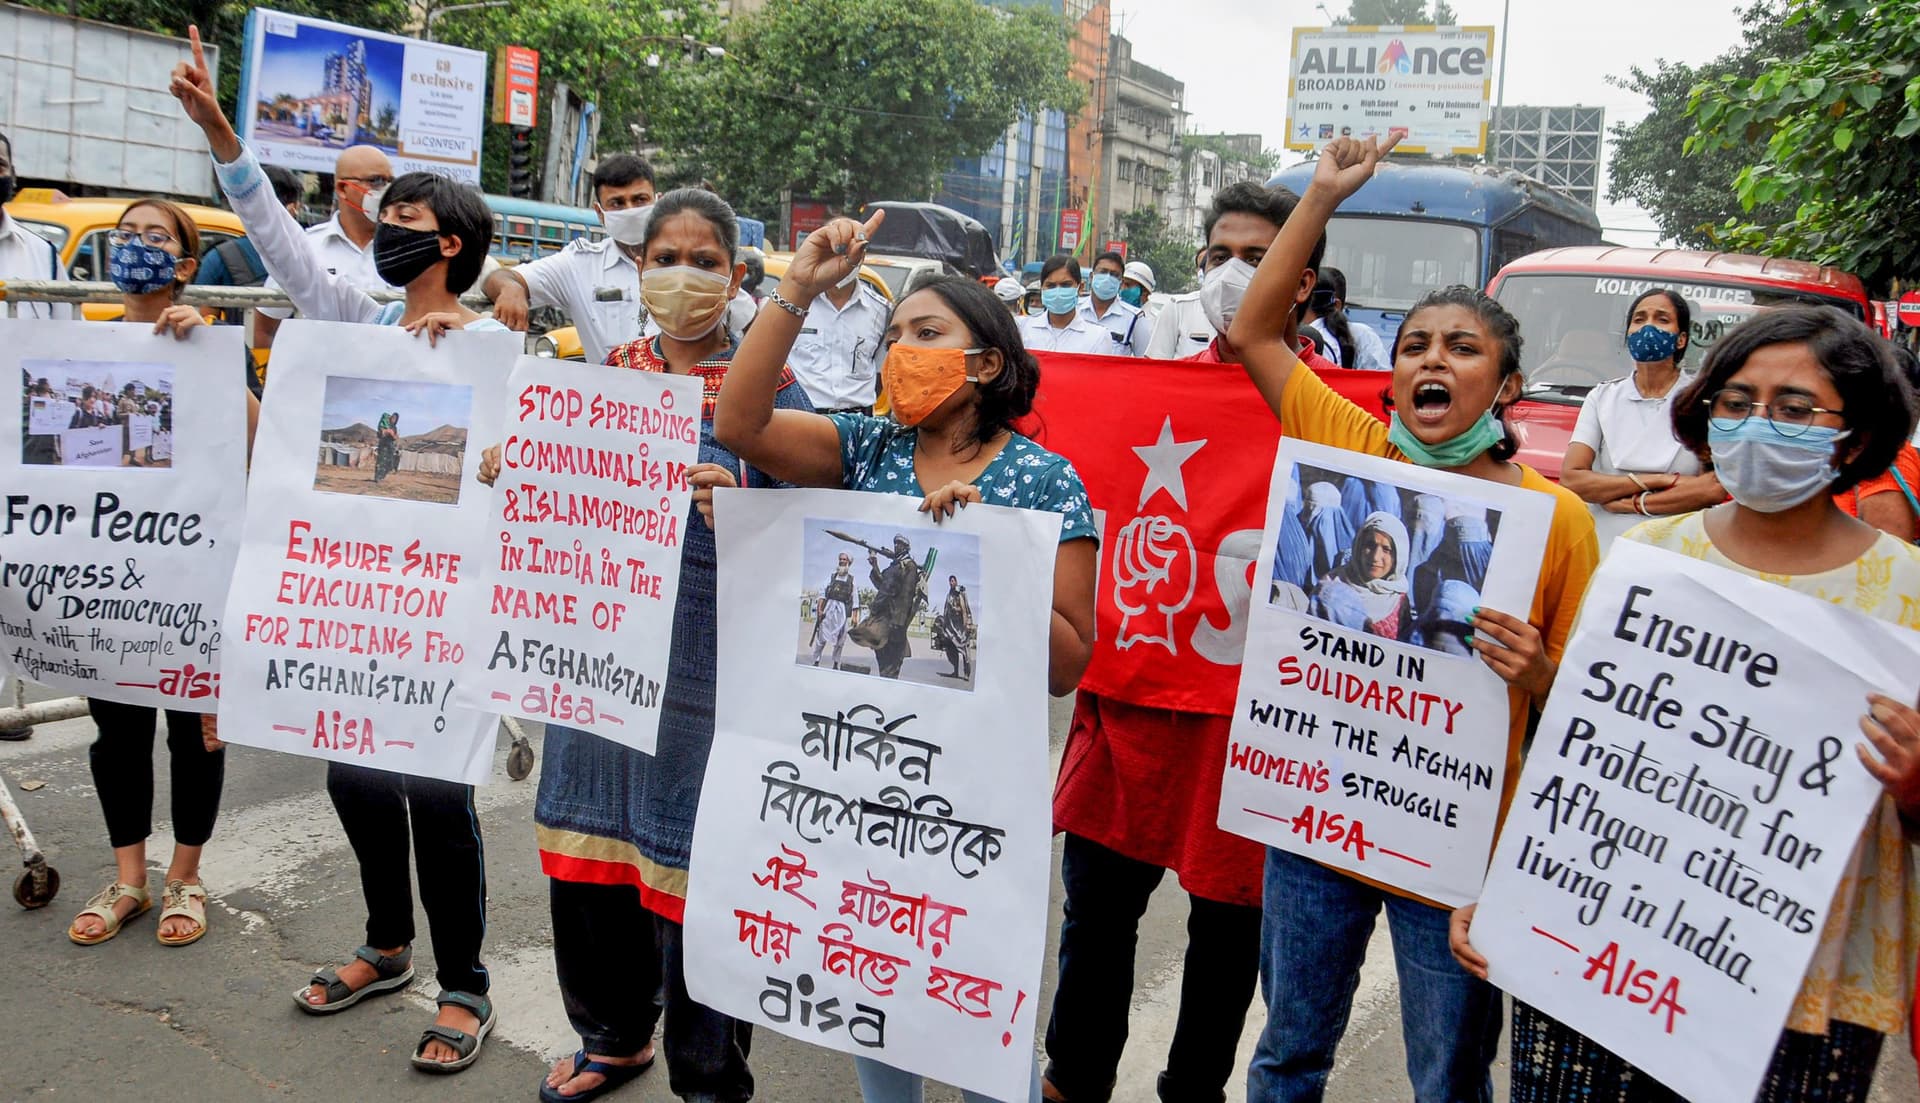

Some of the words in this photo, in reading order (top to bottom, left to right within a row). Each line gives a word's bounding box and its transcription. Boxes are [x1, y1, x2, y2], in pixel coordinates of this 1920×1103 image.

[410, 72, 473, 91] exclusive
[1298, 78, 1386, 91] BROADBAND
[1298, 102, 1314, 110] Free
[1360, 100, 1376, 108] High
[1377, 100, 1399, 108] Speed
[1427, 100, 1444, 109] Truly
[1445, 101, 1481, 109] Unlimited
[1365, 110, 1392, 118] Internet
[1444, 111, 1461, 119] Data
[1680, 287, 1746, 304] POLICE
[518, 384, 583, 427] STOP
[3, 495, 76, 537] For
[91, 492, 215, 549] Peace,
[285, 520, 393, 573] ENSURE
[401, 539, 462, 584] SAFE
[626, 558, 662, 600] THE
[0, 556, 114, 611] rogress
[120, 558, 145, 590] &
[490, 584, 577, 625] NAME
[592, 601, 626, 632] OF
[43, 626, 85, 652] with
[88, 628, 115, 653] the
[120, 632, 175, 665] people
[199, 632, 221, 664] of
[56, 595, 218, 646] Democracy,
[245, 614, 290, 646] FOR
[296, 617, 413, 660] INDIANS
[1613, 585, 1779, 688] Ensure
[1299, 626, 1385, 668] STAND
[1396, 654, 1425, 682] IN
[1278, 656, 1464, 734] SOLIDARITY
[801, 703, 943, 785] মার্কিন
[1249, 699, 1319, 738] WITH
[1332, 720, 1378, 757] THE
[1392, 734, 1493, 792] AFGHAN
[1582, 661, 1683, 730] Safe
[1690, 703, 1795, 804] Stay
[1798, 736, 1842, 797] &
[1229, 742, 1330, 793] WOMEN'S
[1341, 772, 1459, 829] STRUGGLE
[1557, 717, 1749, 839] Protection
[1760, 808, 1824, 872] for
[759, 760, 1006, 879] বিদেশনীতিকে
[1291, 805, 1375, 861] AISA
[1530, 774, 1668, 871] Afhgan
[1683, 847, 1817, 935] citizens
[752, 843, 818, 910] এই
[839, 868, 967, 959] ঘটনার
[1516, 835, 1612, 926] living
[1621, 884, 1659, 930] in
[1662, 899, 1758, 995] India.
[817, 922, 911, 996] নিতে
[759, 973, 887, 1048] aisa
[1583, 941, 1687, 1034] AISA
